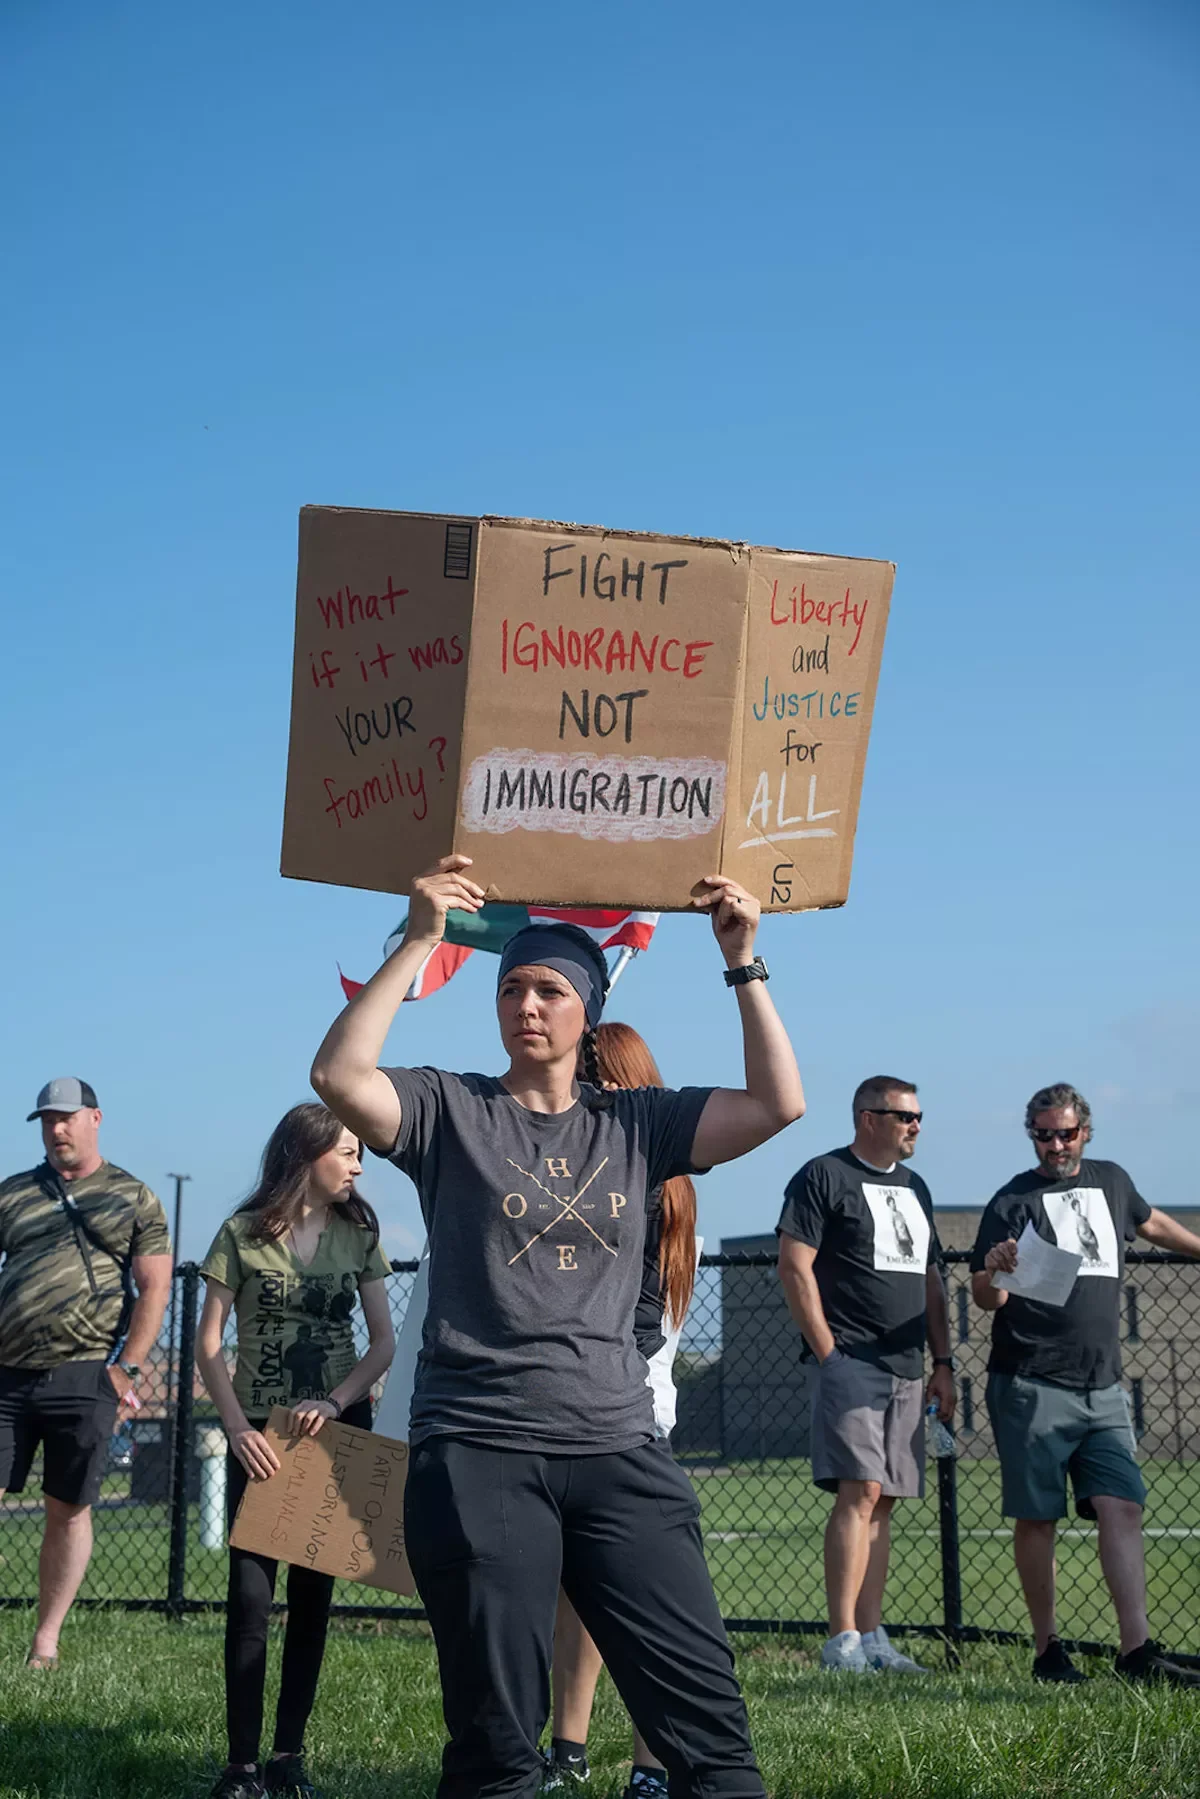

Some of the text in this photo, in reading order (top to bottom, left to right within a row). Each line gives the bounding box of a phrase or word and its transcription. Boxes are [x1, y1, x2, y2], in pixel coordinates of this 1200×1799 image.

[542, 544, 688, 605] FIGHT
[770, 579, 868, 656] Liberty
[309, 635, 463, 688] if it was
[501, 619, 714, 679] IGNORANCE
[792, 635, 830, 674] and
[558, 689, 649, 743] NOT
[753, 676, 861, 721] JUSTICE
[335, 696, 416, 756] YOUR
[780, 729, 823, 766] for
[482, 768, 712, 819] IMMIGRATION
[747, 771, 840, 828] ALL
[252, 1340, 284, 1388] BOYZ
[252, 1390, 288, 1407] Los
[369, 1443, 408, 1496] PART
[304, 1527, 328, 1566] NOT
